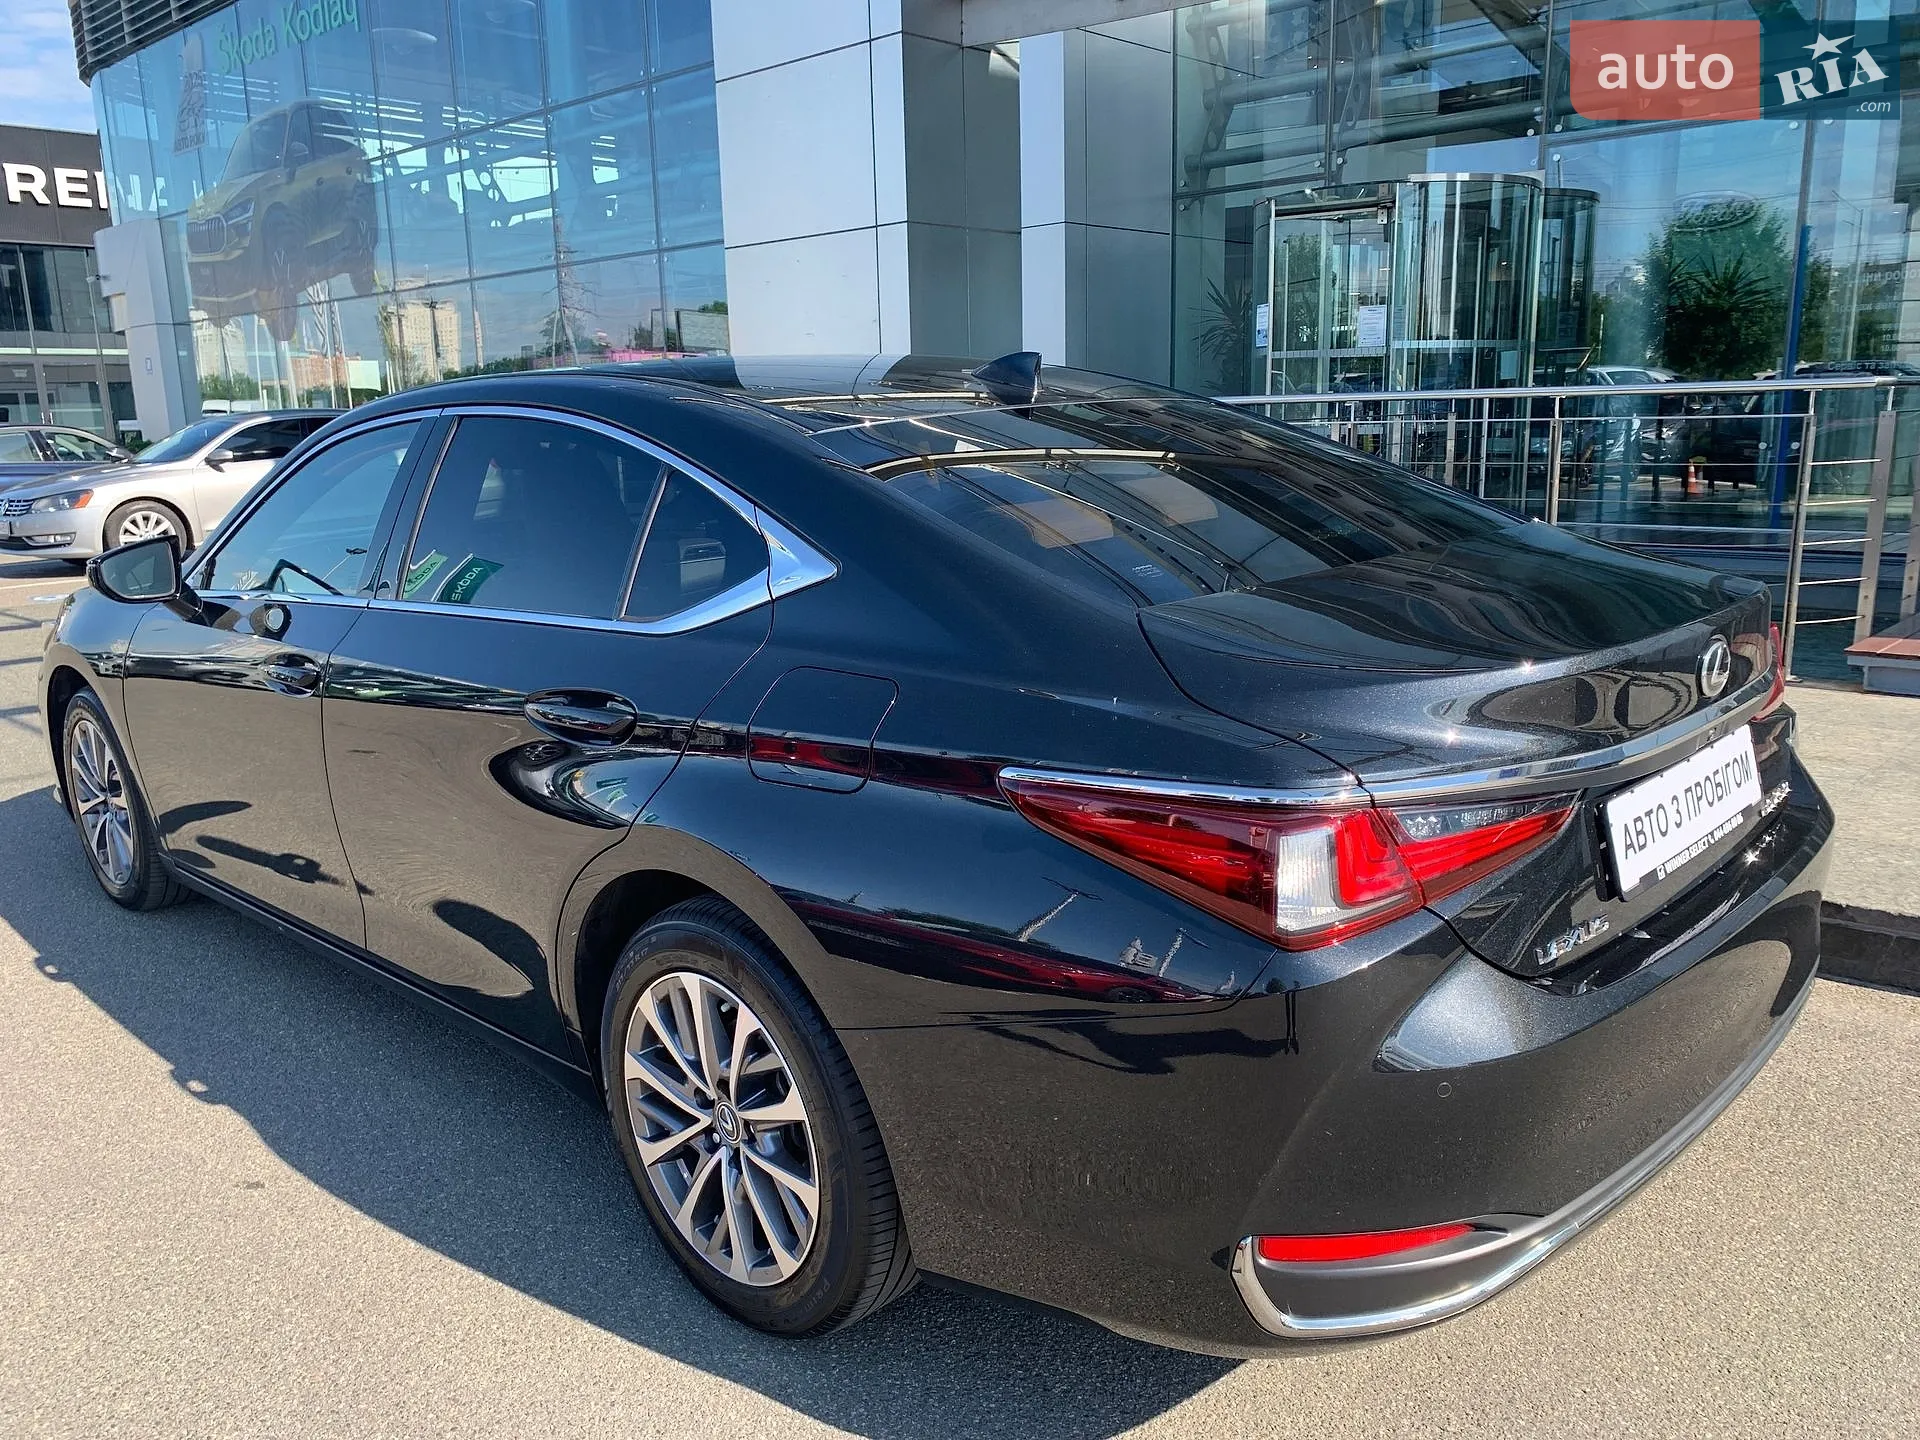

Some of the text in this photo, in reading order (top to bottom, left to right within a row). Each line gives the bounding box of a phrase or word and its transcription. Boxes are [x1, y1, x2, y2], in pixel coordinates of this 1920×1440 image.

[1623, 803, 1669, 860] АВТО
[1684, 750, 1753, 822] ПРОБІГОМ
[1664, 849, 1690, 874] WINNER
[1689, 834, 1709, 858] SELECT
[1535, 914, 1609, 965] LEXUS
